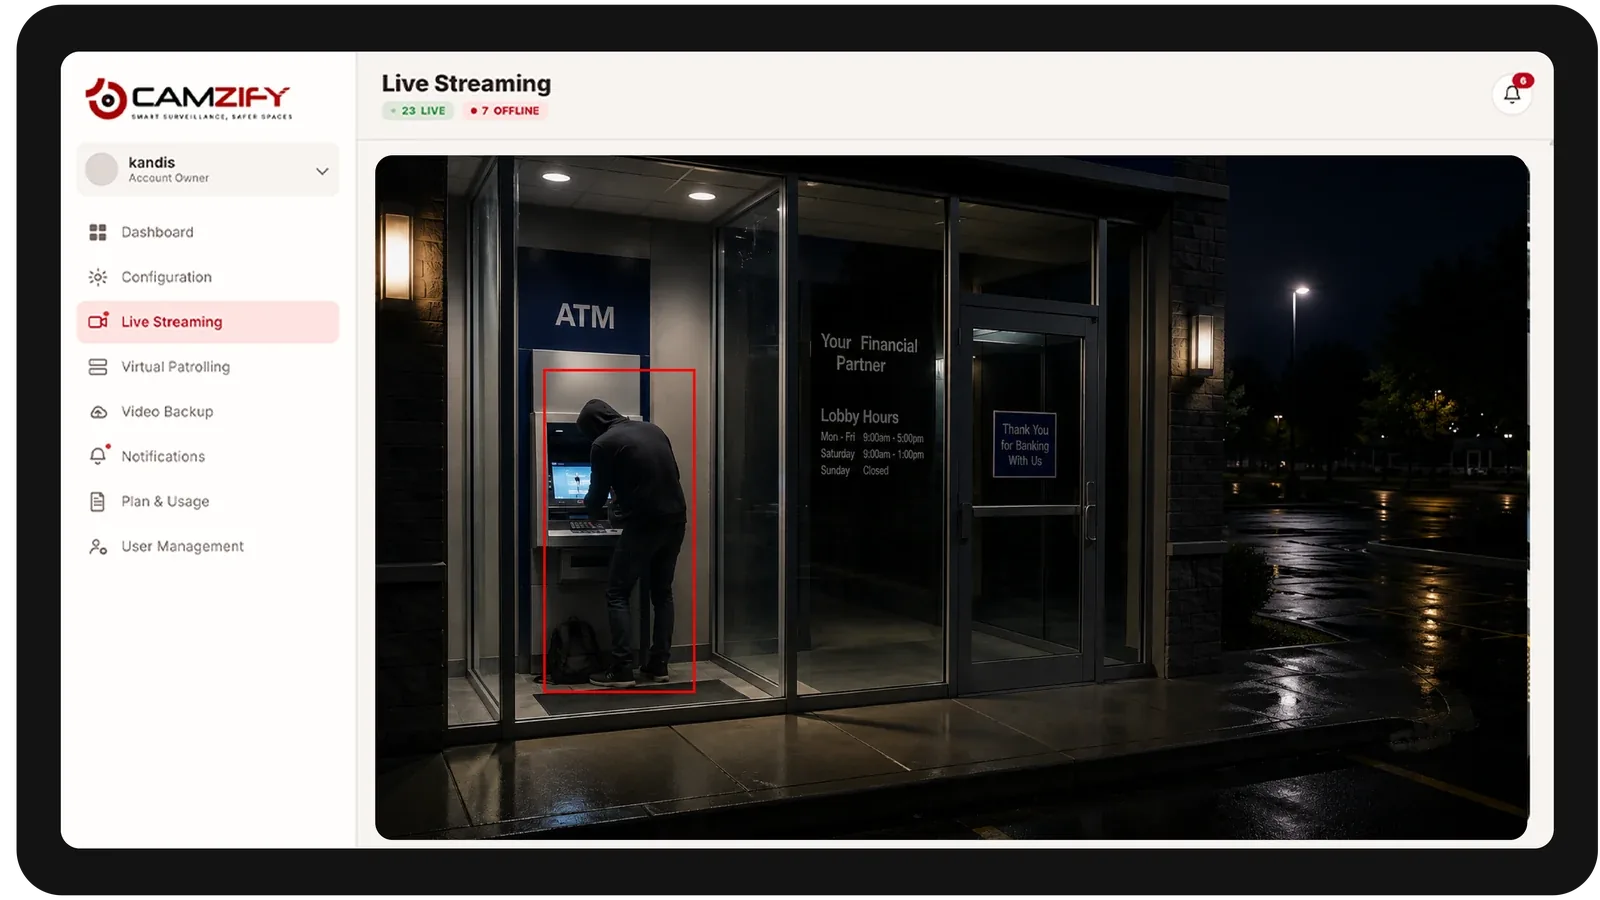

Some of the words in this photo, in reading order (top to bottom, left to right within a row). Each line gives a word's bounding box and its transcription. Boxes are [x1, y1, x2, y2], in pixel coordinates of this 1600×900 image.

[383, 74, 429, 92] Live
[435, 74, 551, 96] Streaming
[1520, 77, 1526, 85] 6
[133, 87, 290, 107] CAMZIFY
[402, 107, 416, 115] 23
[421, 107, 445, 115] LIVE
[482, 106, 488, 115] 7
[494, 107, 539, 115] OFFLINE
[162, 113, 228, 121] SURVEILLANCE,
[129, 156, 175, 168] kandis
[129, 173, 172, 182] Account
[175, 173, 208, 182] Owner
[122, 226, 193, 238] Dashboard
[122, 271, 212, 285] Configuration
[555, 303, 614, 329] ATM
[122, 316, 149, 328] Live
[154, 316, 222, 330] Streaming
[821, 333, 851, 349] Your
[861, 336, 917, 353] Financial
[122, 360, 164, 372] Virtual
[169, 361, 230, 375] Patrolling
[837, 355, 886, 372] Partner
[122, 406, 160, 417] Video
[165, 406, 213, 420] Backup
[821, 408, 859, 426] Lobby
[863, 410, 898, 424] Hours
[1003, 423, 1030, 434] Thank
[1033, 425, 1048, 435] You
[821, 432, 838, 441] Mon
[846, 432, 855, 441] Fri
[863, 433, 890, 442] 9:00am
[897, 433, 924, 444] 5:00pm
[1001, 440, 1013, 450] for
[1016, 440, 1049, 453] Banking
[122, 450, 205, 462] Notifications
[821, 448, 855, 460] Saturday
[863, 449, 890, 458] 9:00am
[898, 450, 924, 460] 1:00pm
[1009, 455, 1028, 465] With
[1031, 456, 1042, 466] Us
[821, 465, 850, 477] Sunday
[863, 465, 889, 475] Closed
[122, 495, 150, 507] Plan
[154, 496, 163, 507] &
[168, 496, 209, 510] Usage
[122, 541, 152, 552] User
[158, 541, 244, 555] Management
